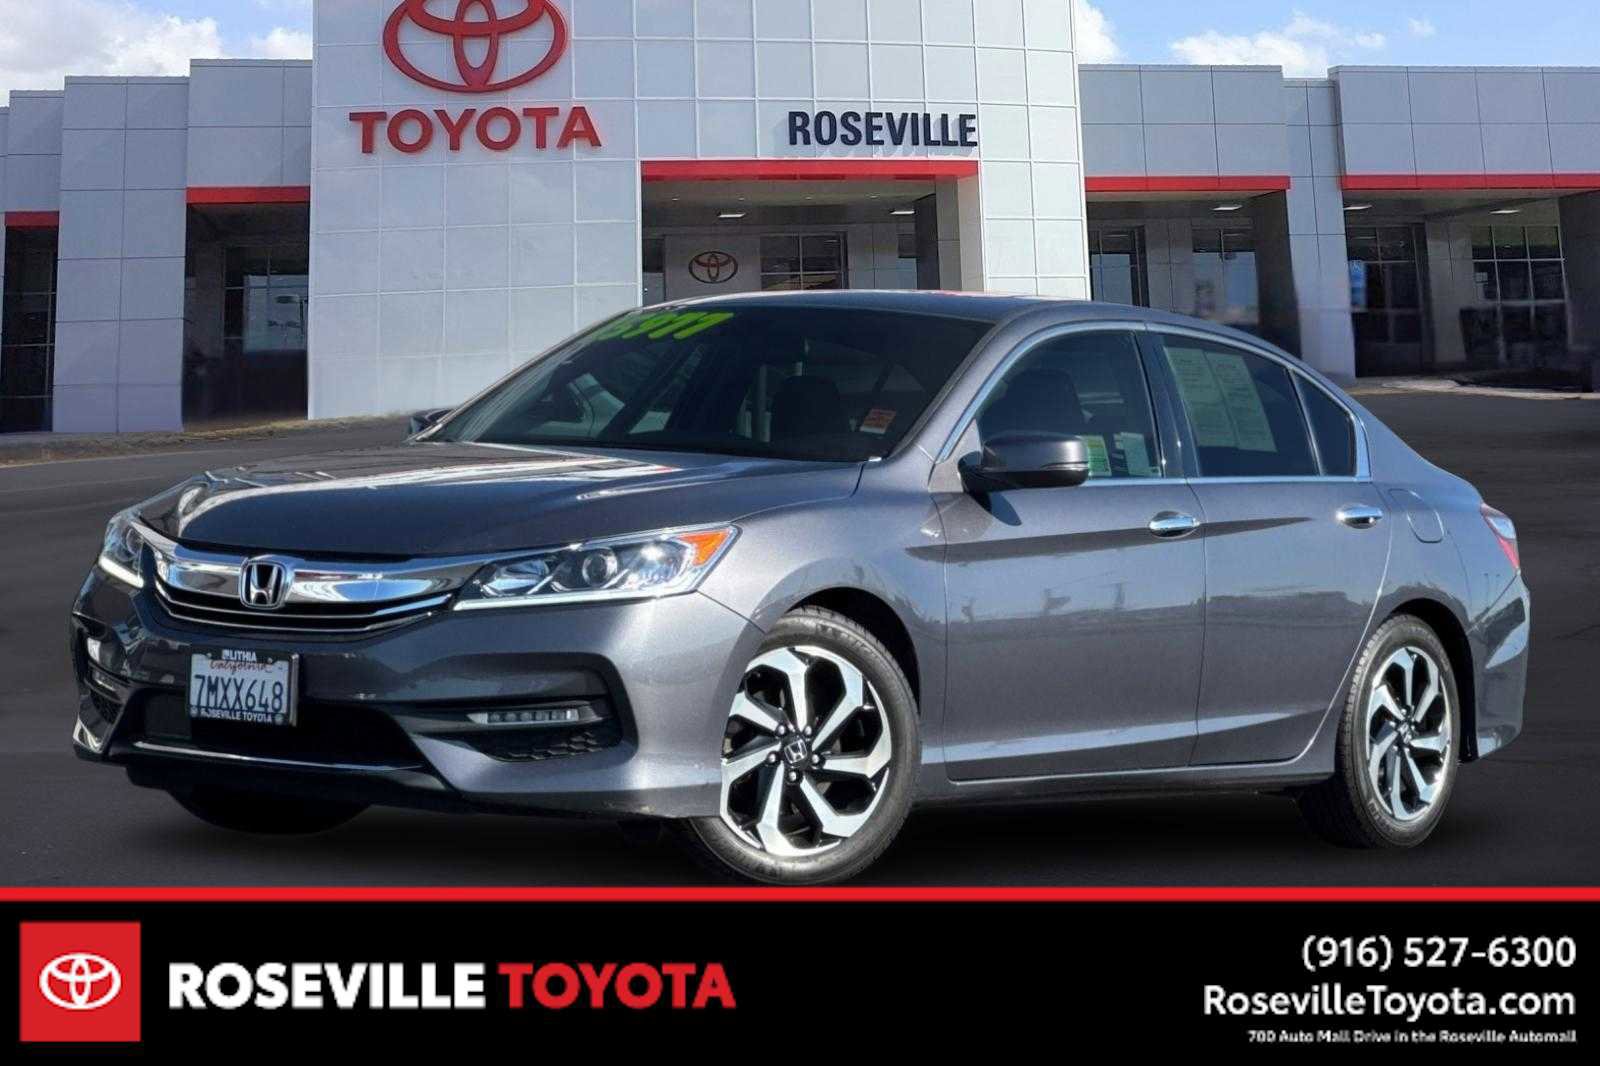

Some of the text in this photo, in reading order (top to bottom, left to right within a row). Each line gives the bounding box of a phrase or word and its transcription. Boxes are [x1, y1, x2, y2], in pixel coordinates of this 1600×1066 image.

[350, 107, 602, 153] TOYOTA
[789, 111, 978, 147] ROSEVILLE
[229, 650, 258, 662] LITHIA
[194, 675, 284, 712] 7MXX648
[243, 711, 273, 722] TOYOTA
